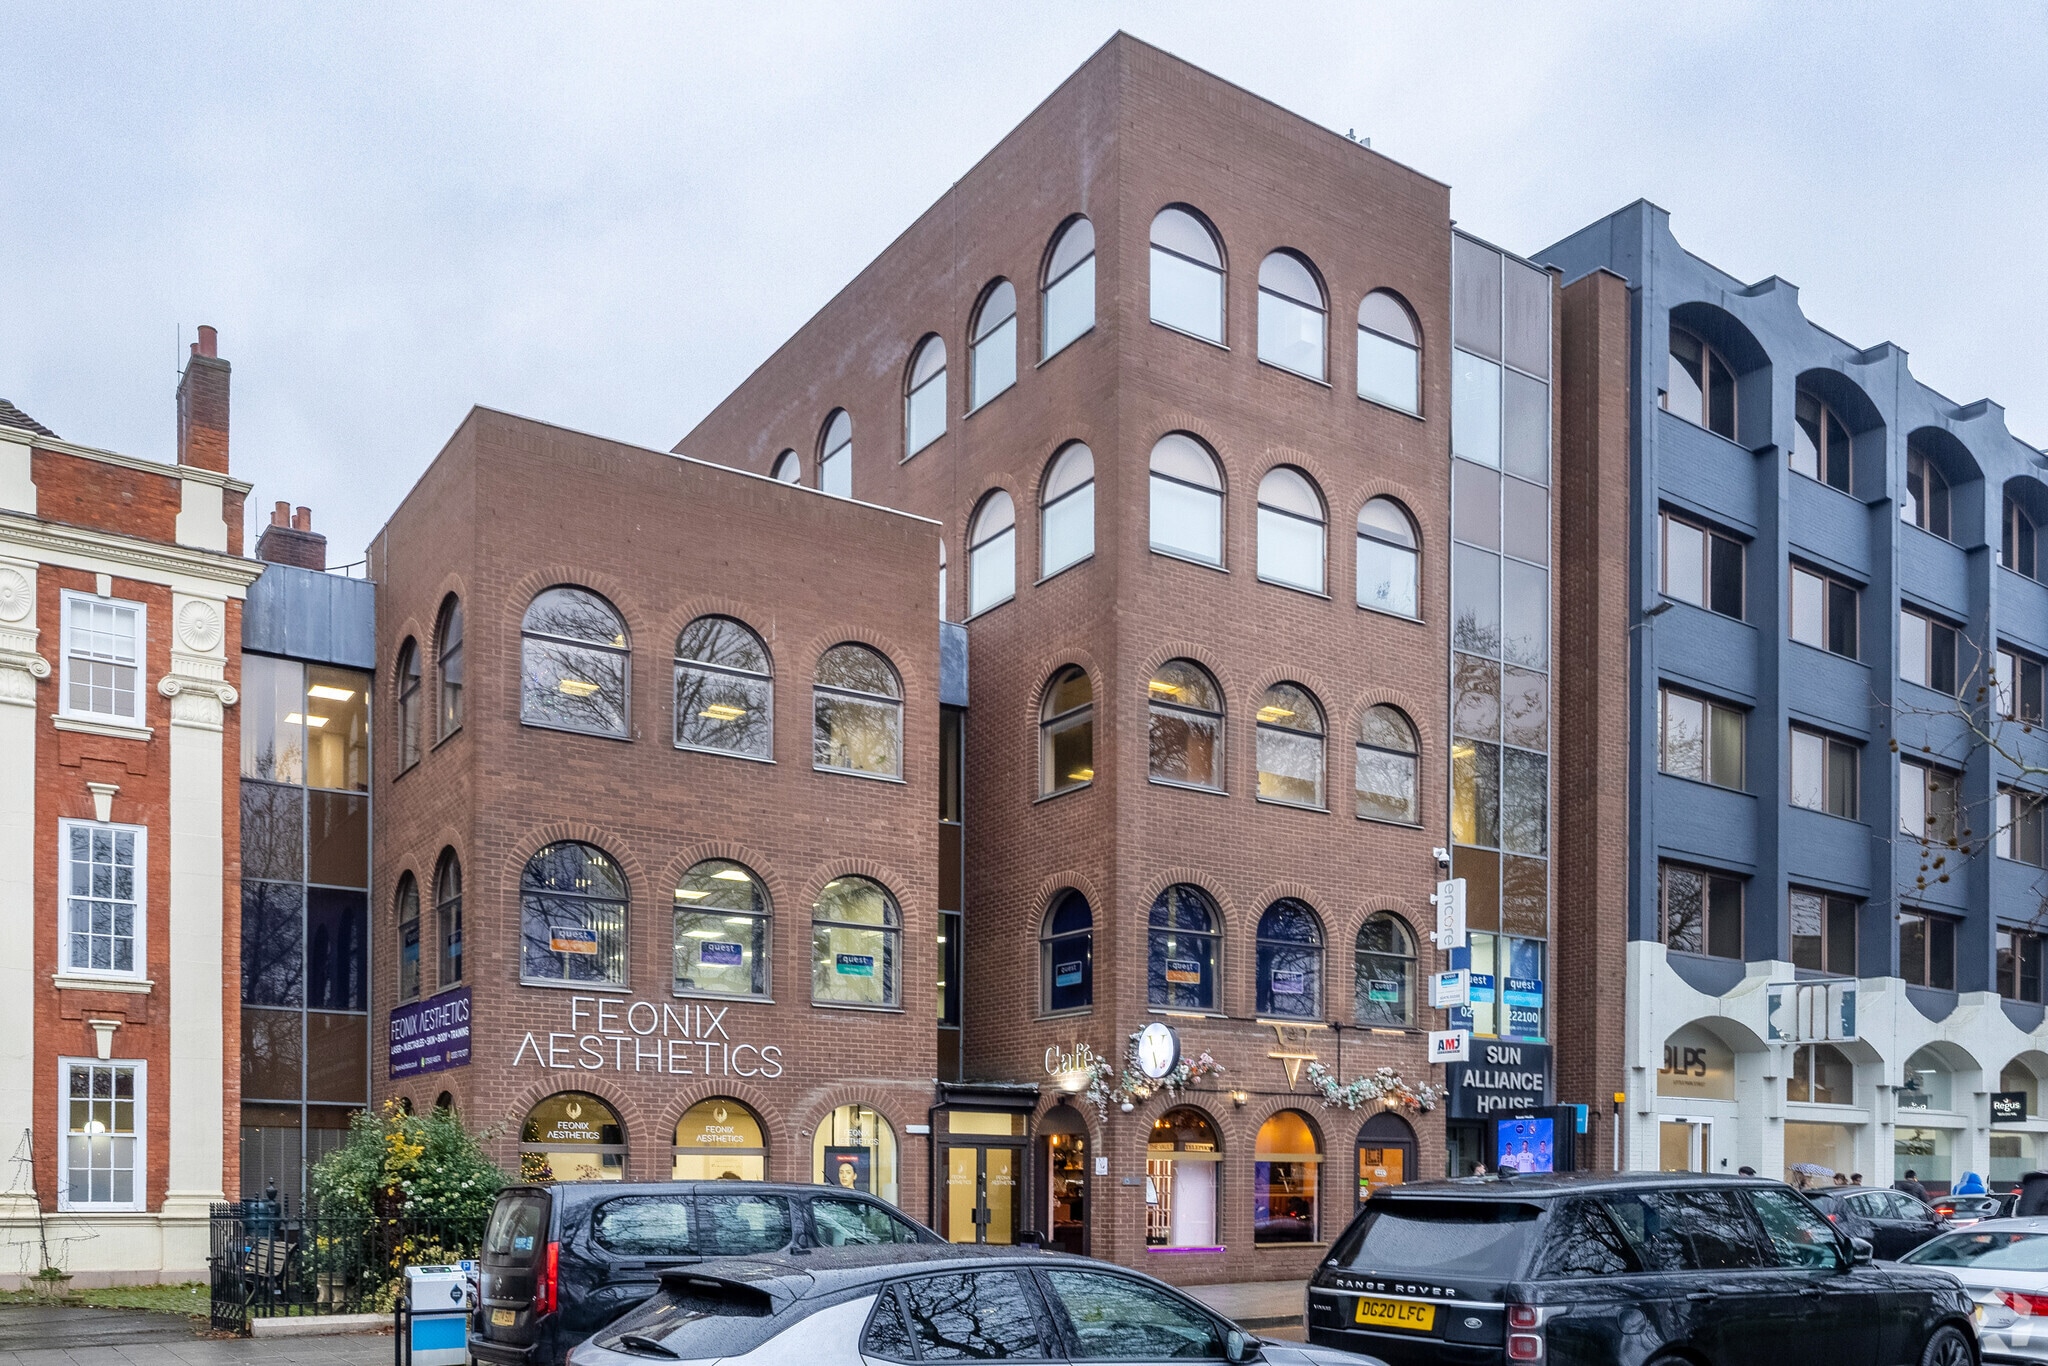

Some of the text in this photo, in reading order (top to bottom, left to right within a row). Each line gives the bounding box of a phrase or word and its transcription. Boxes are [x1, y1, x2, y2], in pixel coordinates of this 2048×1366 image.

[1444, 883, 1454, 946] encore
[559, 930, 589, 939] quest
[708, 944, 735, 952] quest
[1510, 980, 1535, 990] quest
[391, 998, 469, 1041] FEONIX AESTHETICS
[572, 996, 729, 1040] FEONIX
[513, 1032, 783, 1078] AESTHETICS
[1045, 1042, 1094, 1076] Café
[1487, 1045, 1522, 1065] SUN
[1462, 1069, 1544, 1091] ALLIANCE
[1477, 1095, 1535, 1113] HOUSE
[1993, 1101, 2021, 1112] Regus
[557, 1121, 590, 1130] FEONIX
[705, 1125, 735, 1133] FEONIX
[546, 1131, 600, 1140] AESTHETICS
[695, 1134, 744, 1143] AESTHETICS
[1336, 1279, 1456, 1297] RANGE ROVER
[1362, 1301, 1426, 1322] DG20 LFC
